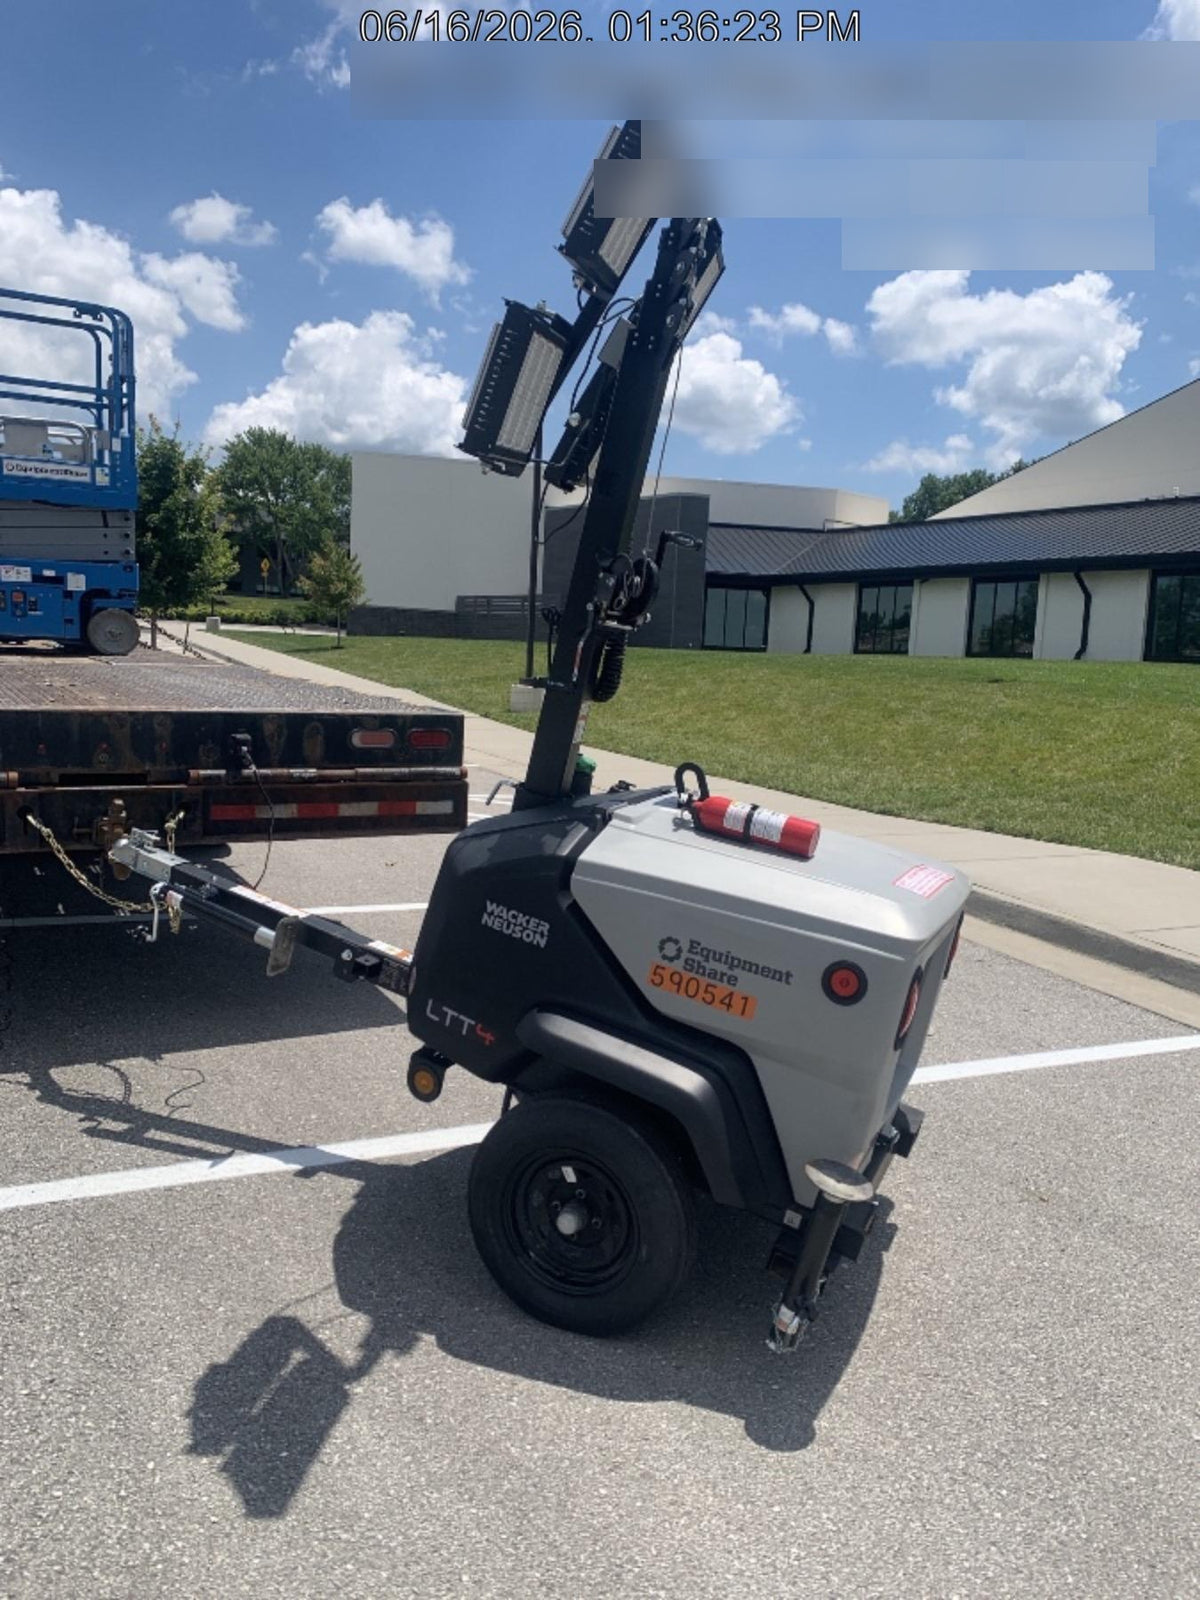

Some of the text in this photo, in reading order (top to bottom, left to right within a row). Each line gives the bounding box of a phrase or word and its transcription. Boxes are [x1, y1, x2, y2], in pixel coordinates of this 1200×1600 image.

[481, 911, 548, 948] NEUSON
[486, 899, 550, 936] WACKER
[683, 957, 738, 987] Share
[687, 938, 793, 985] Equipment
[650, 964, 750, 1017] 590541
[426, 998, 495, 1046] LTT4
